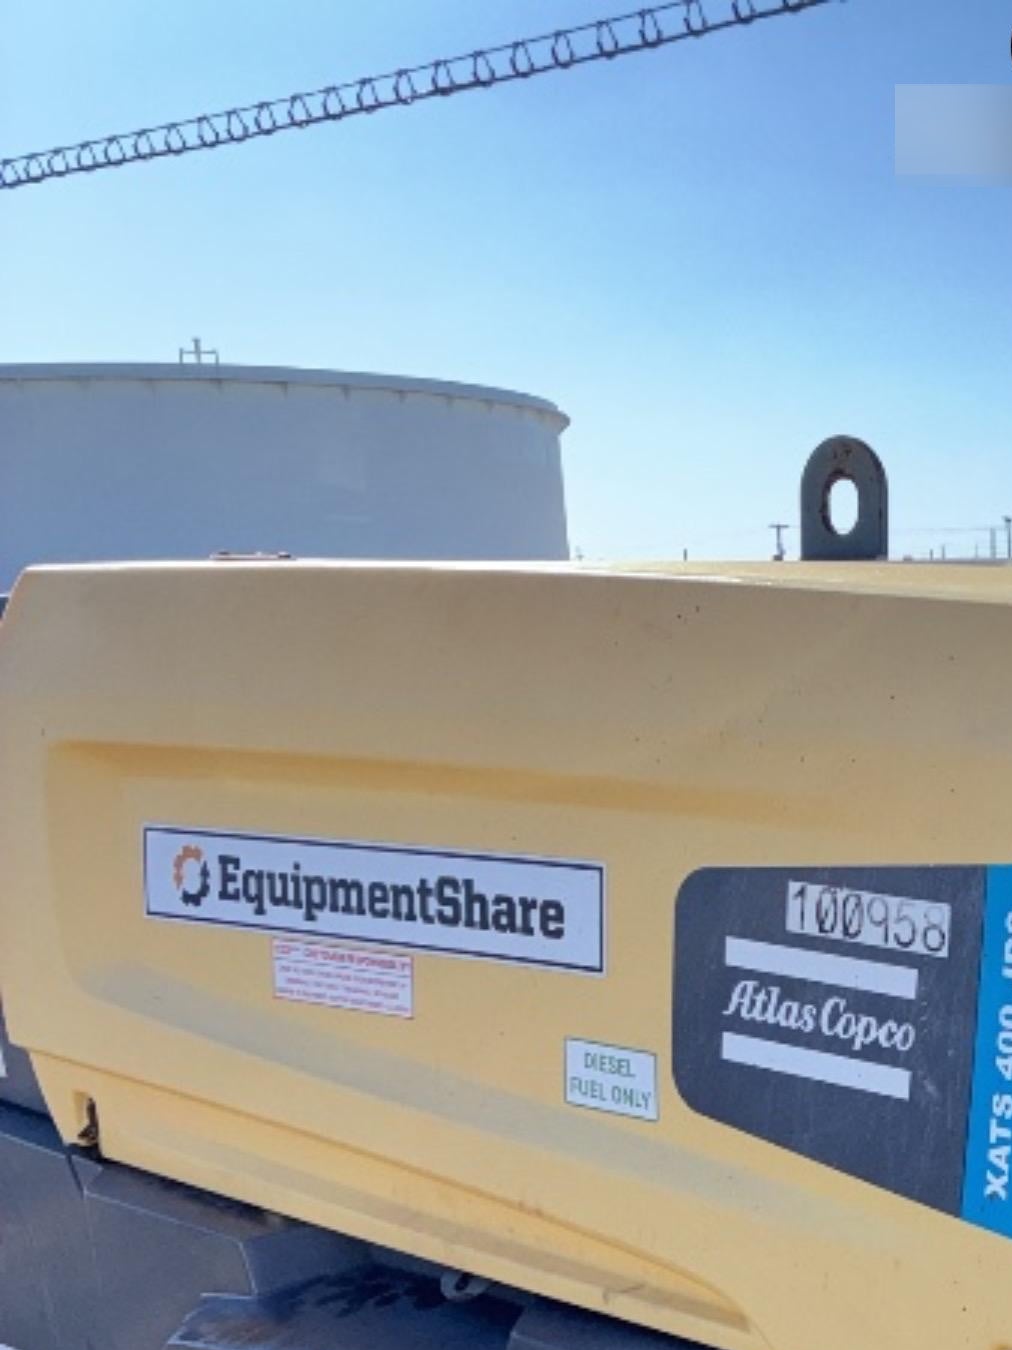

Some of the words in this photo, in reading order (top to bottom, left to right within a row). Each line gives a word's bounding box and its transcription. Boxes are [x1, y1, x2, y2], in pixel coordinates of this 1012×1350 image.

[217, 855, 565, 939] EquipmentShare
[793, 884, 946, 952] 100958
[722, 979, 817, 1033] Atlas
[820, 996, 916, 1051] Copco
[570, 1076, 607, 1101] FUEL
[611, 1085, 652, 1111] ONLY
[584, 1052, 636, 1078] DIESEL
